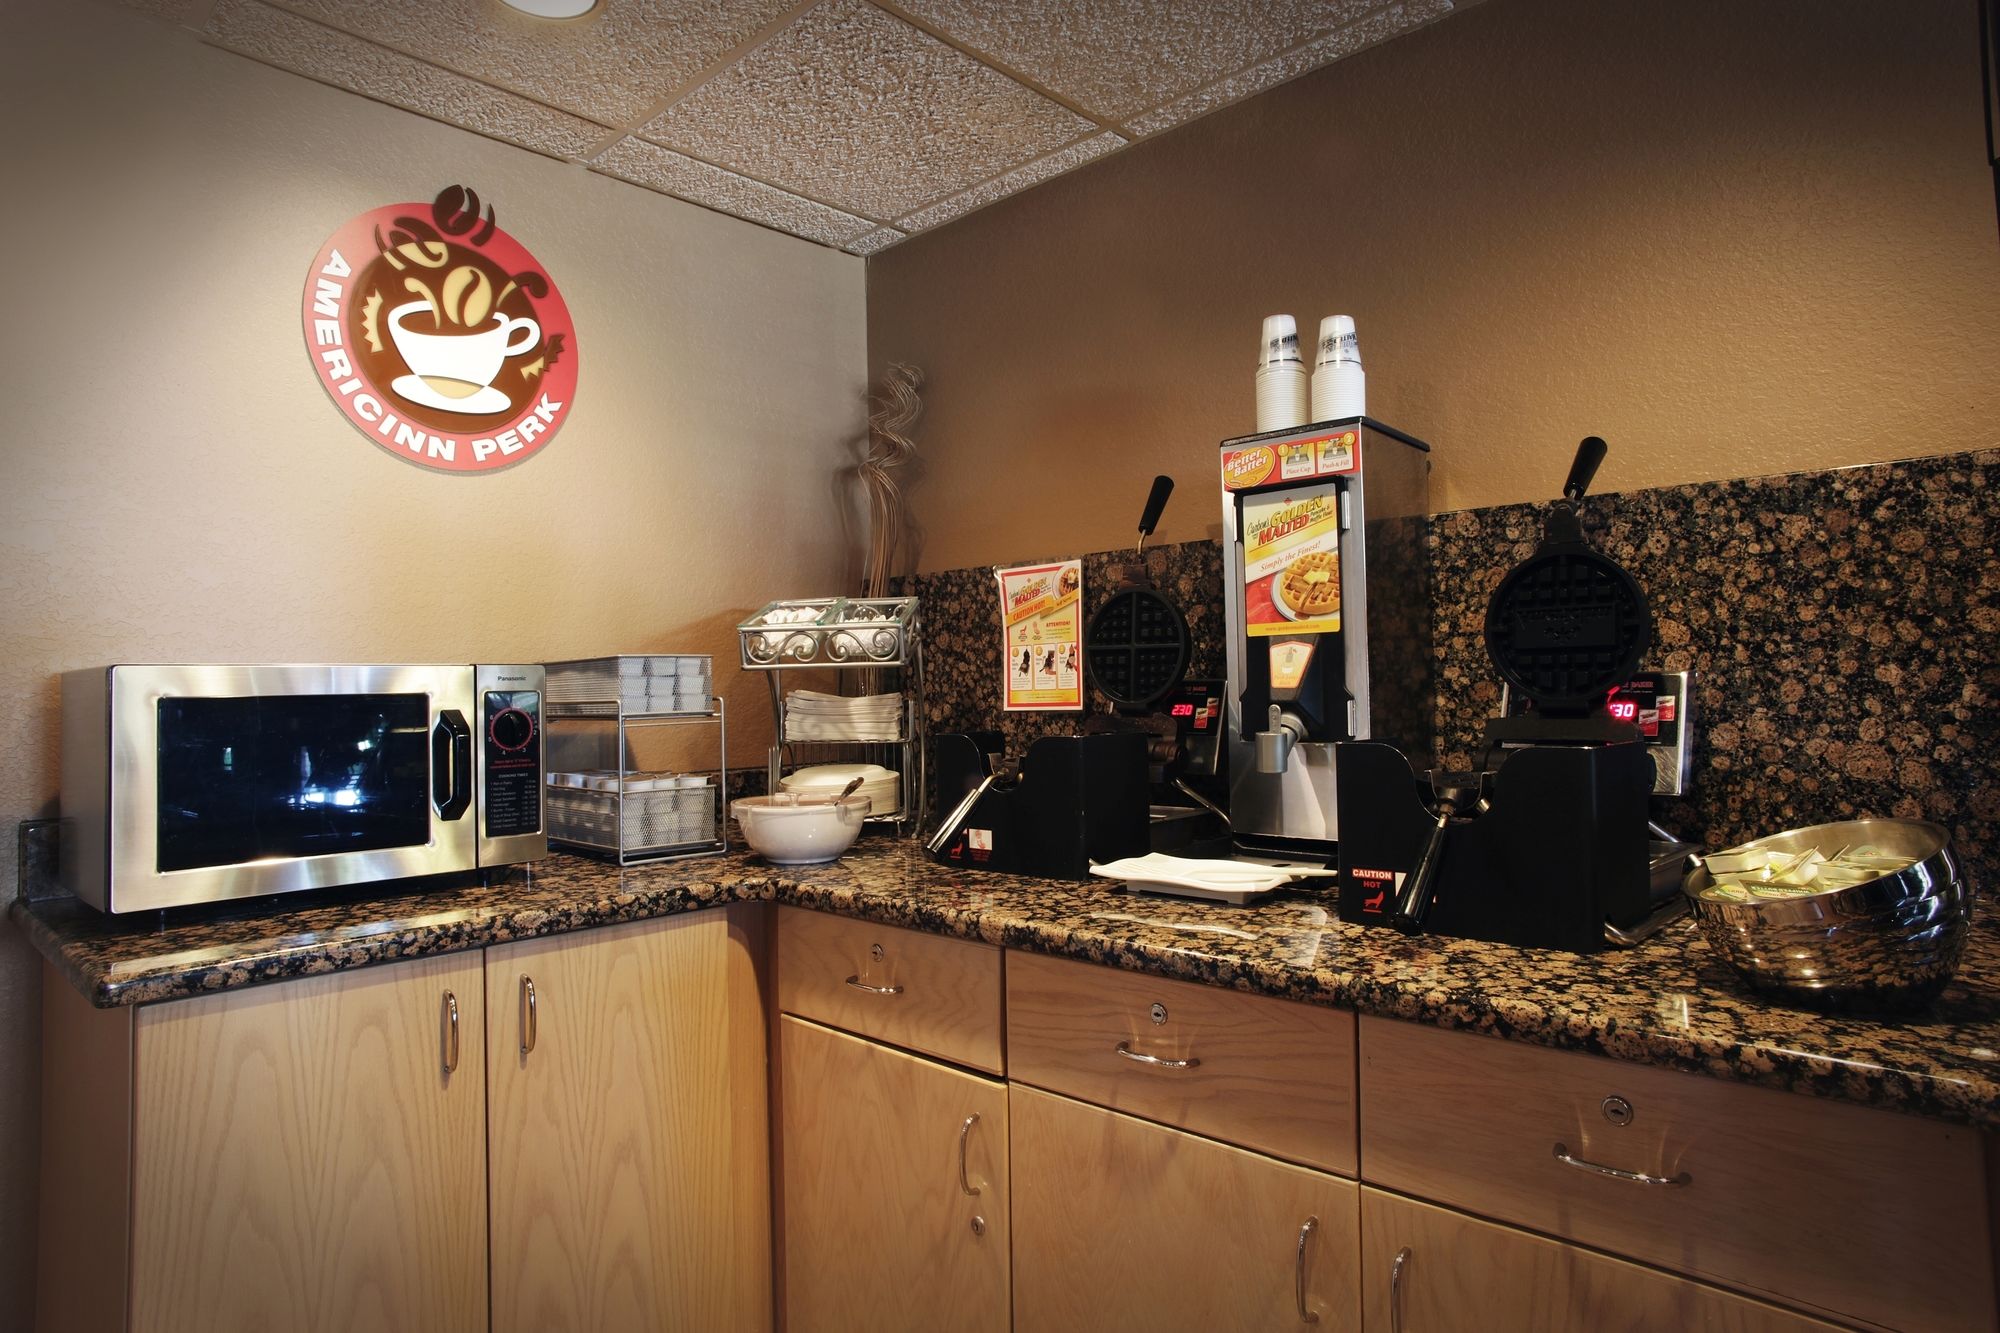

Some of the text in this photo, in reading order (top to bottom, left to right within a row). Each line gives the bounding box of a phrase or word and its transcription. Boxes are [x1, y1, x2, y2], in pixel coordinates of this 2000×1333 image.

[313, 249, 563, 462] AMERICINN PERK
[1226, 449, 1262, 472] Better
[1233, 455, 1268, 478] Batter
[1300, 466, 1312, 474] Cup
[1270, 495, 1324, 528] GOLDEN
[1258, 513, 1310, 546] MALTED
[1261, 540, 1321, 572] Simply the Finest!
[1171, 704, 1193, 715] 230
[1610, 703, 1634, 717] 30
[1352, 869, 1392, 880] CAUTION
